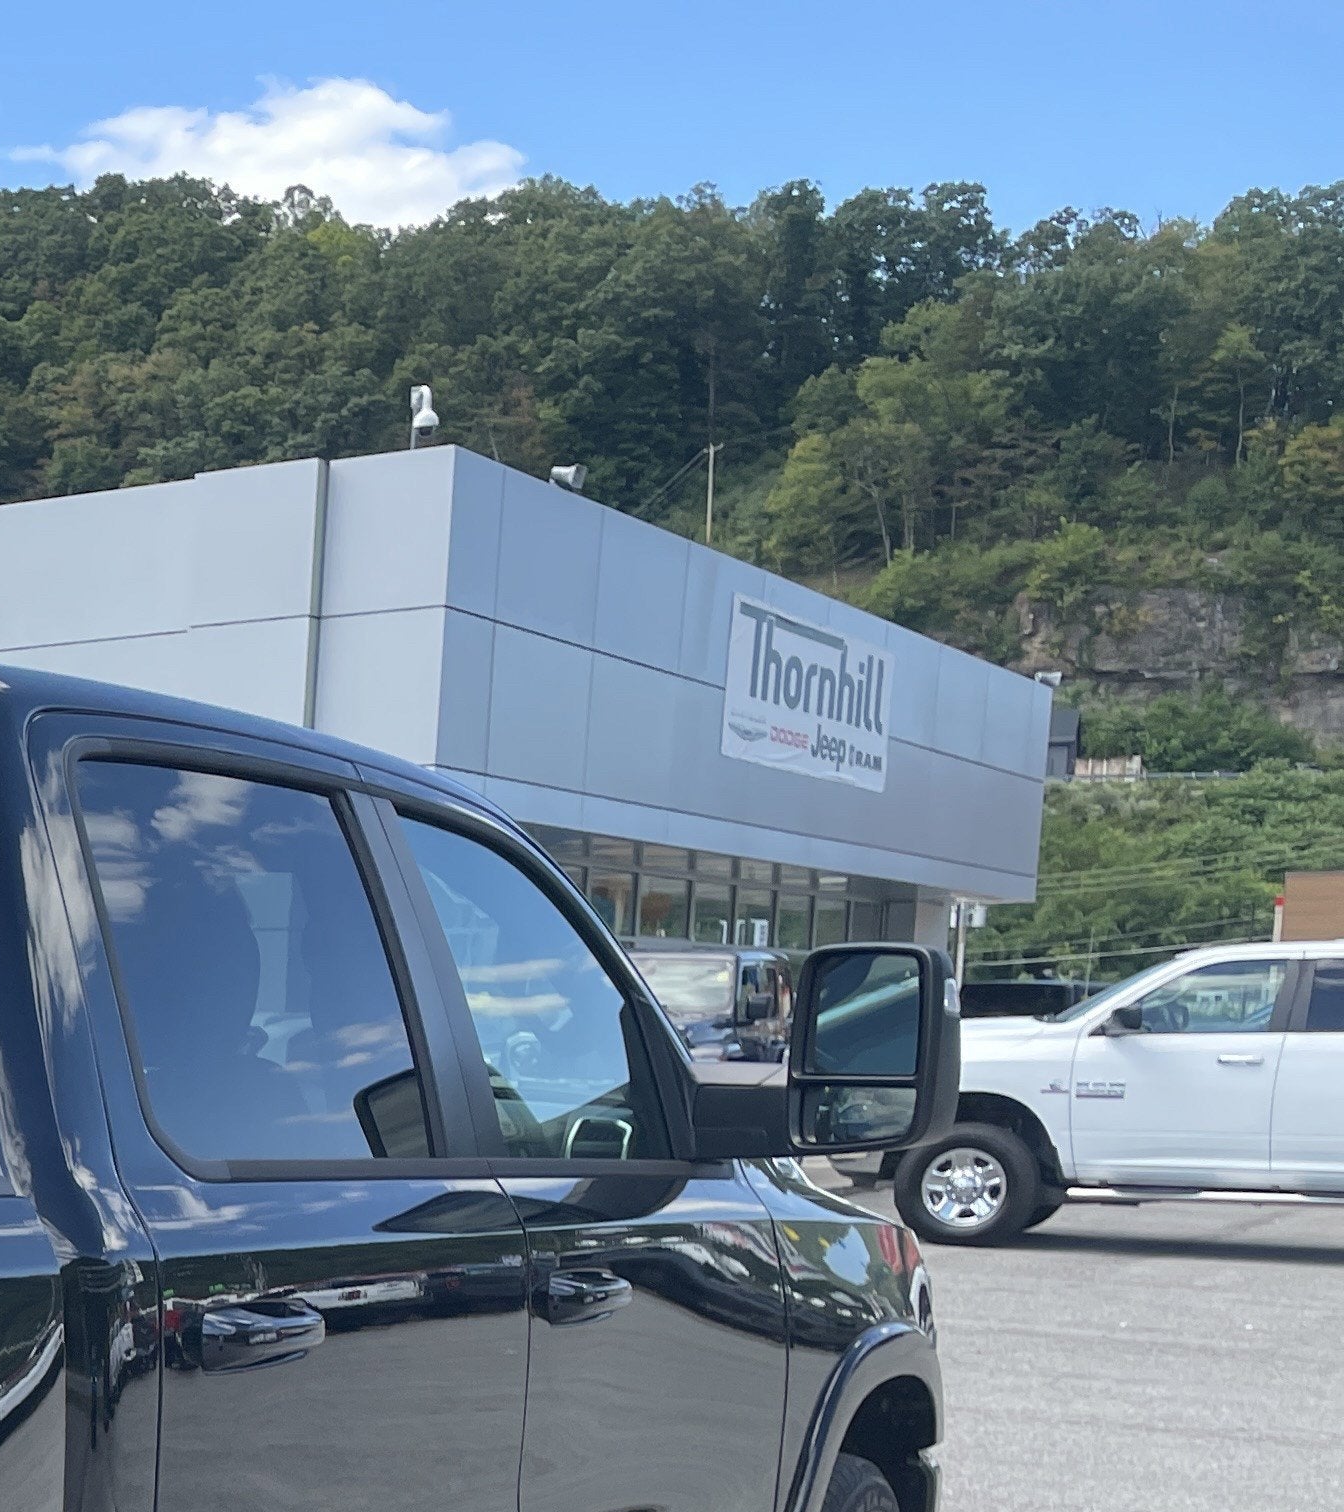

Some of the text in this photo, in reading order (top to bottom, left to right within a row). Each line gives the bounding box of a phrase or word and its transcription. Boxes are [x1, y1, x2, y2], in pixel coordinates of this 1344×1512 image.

[740, 602, 885, 736] Thornhill
[811, 723, 847, 772] Jeep
[855, 751, 883, 772] RAM
